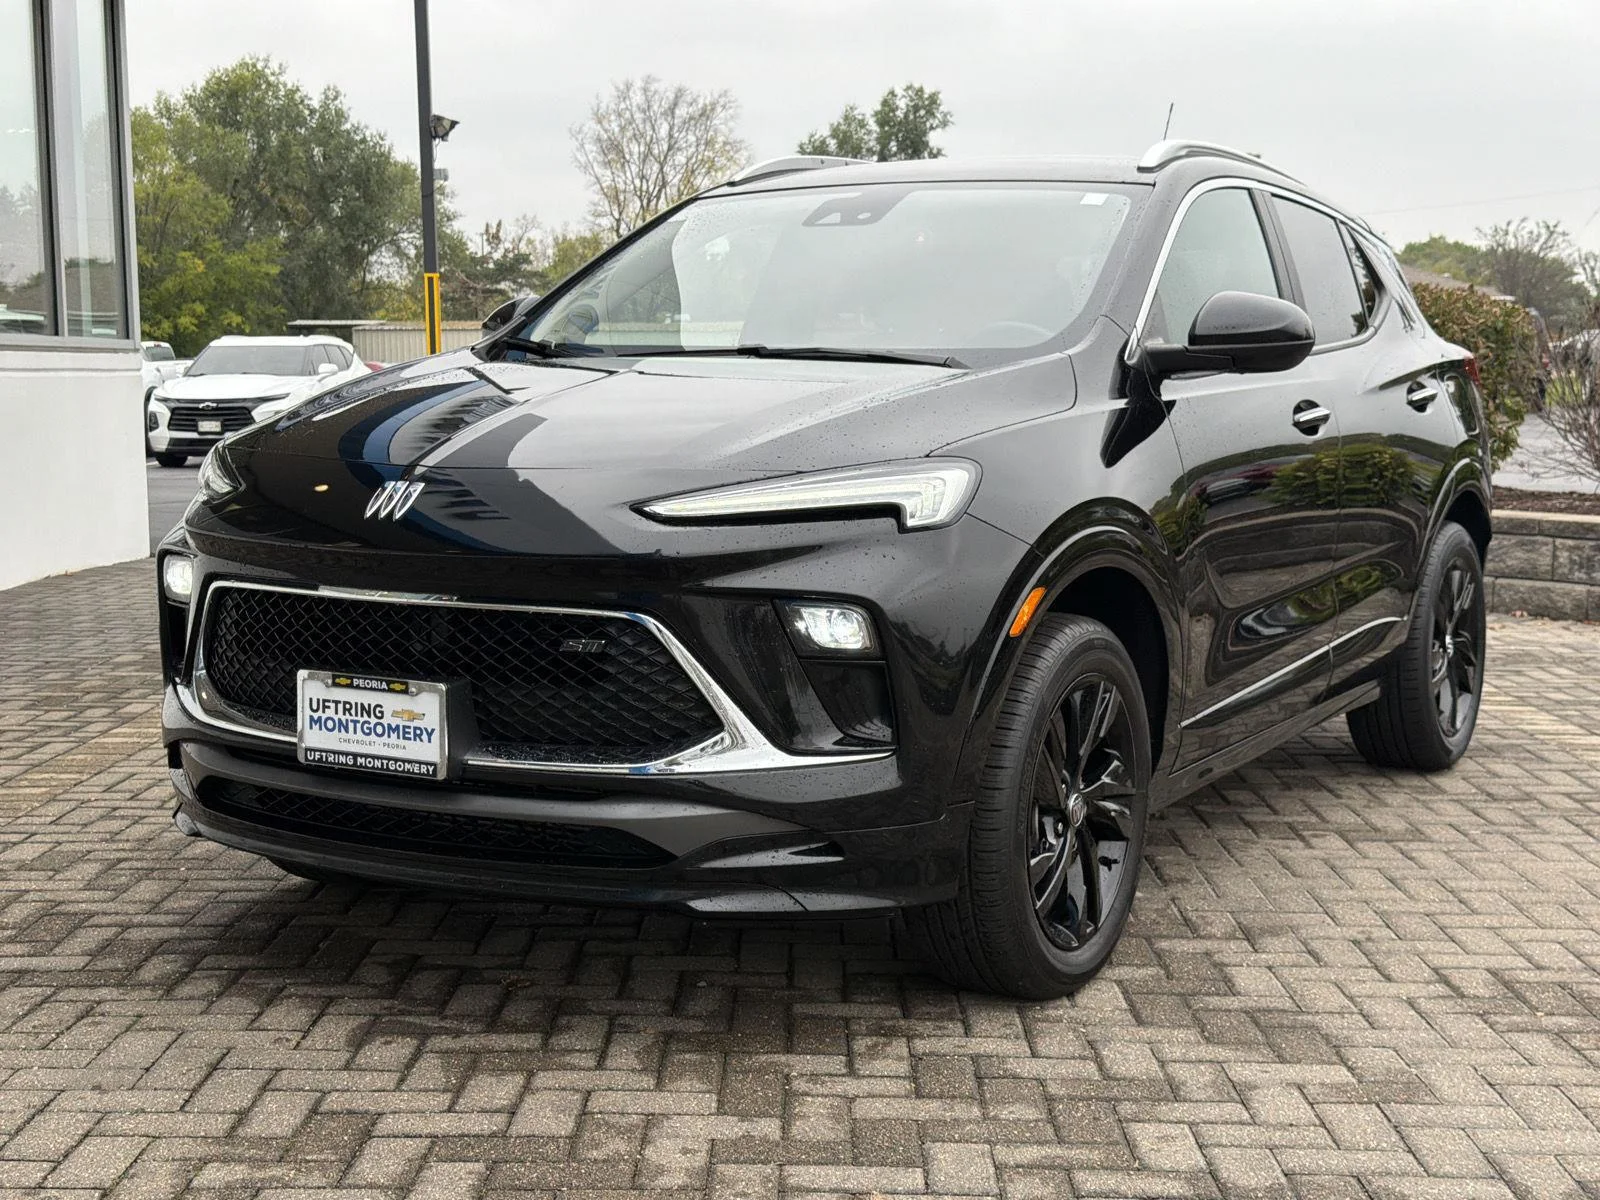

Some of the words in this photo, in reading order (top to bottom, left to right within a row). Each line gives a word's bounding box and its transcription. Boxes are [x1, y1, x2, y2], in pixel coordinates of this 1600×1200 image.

[353, 678, 388, 690] PEORIA
[309, 697, 384, 720] UFTRING
[309, 715, 436, 743] MONTGOMERY
[338, 737, 376, 747] CHEVROLET
[383, 742, 407, 750] PEORIA
[307, 751, 354, 765] UFTRING
[357, 756, 435, 775] MONTGOMERY
